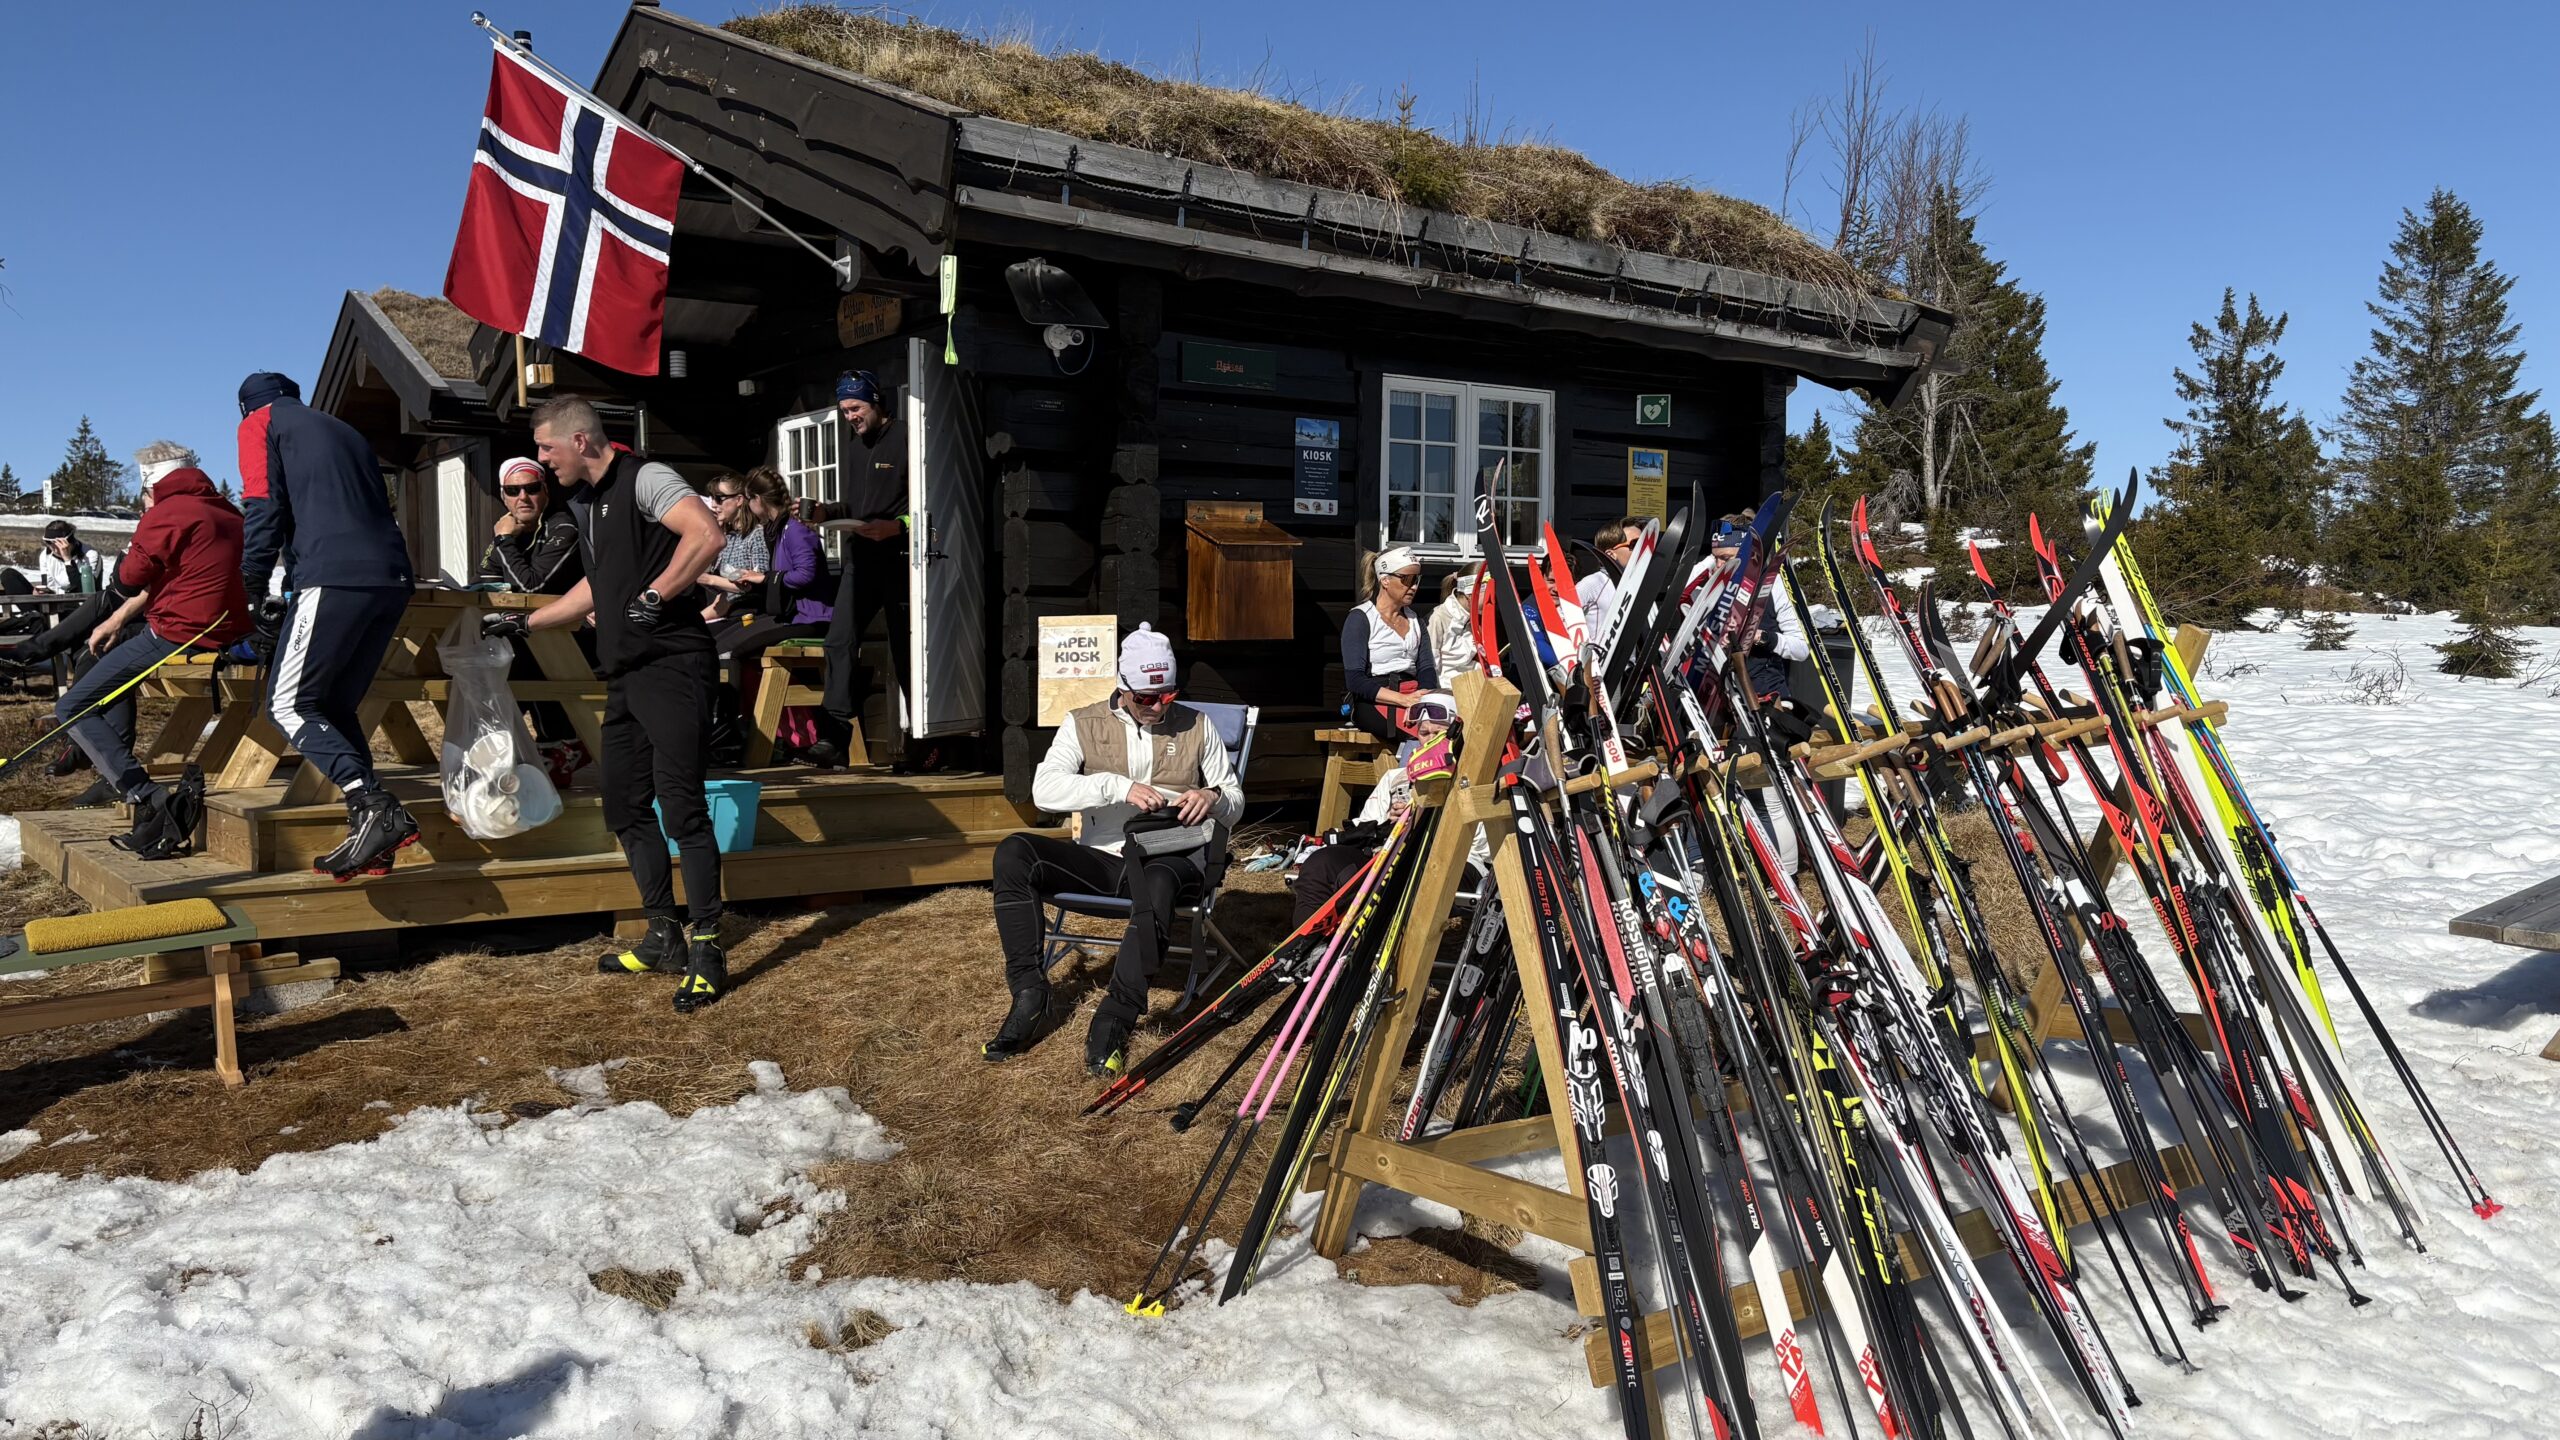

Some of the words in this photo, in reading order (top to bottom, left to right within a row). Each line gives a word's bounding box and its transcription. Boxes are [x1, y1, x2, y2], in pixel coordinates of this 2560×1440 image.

[1303, 450, 1332, 461] KIOSK
[2119, 541, 2173, 646] FISCHER
[294, 623, 304, 651] CRAFT
[1055, 651, 1100, 663] KIOSK
[1408, 759, 1433, 774] LEKI
[1600, 765, 1621, 840] SWIX
[2228, 837, 2264, 913] FISCHER
[1534, 868, 1551, 917] REDSTER
[1546, 920, 1556, 934] C9
[2171, 884, 2200, 949] ROSSIGNOL
[2151, 895, 2185, 955] ROSSIGNOL
[1611, 901, 1643, 996] ROSSIGNOL
[1617, 899, 1657, 994] ROSSIGNOL
[1240, 955, 1275, 989] ROSSIGNOL
[1353, 964, 1383, 1033] FISCHER
[2076, 987, 2091, 1014] R-SKIN
[1605, 1035, 1629, 1092] ATOMIC
[1901, 983, 1992, 1155] MADSHUS
[1740, 1179, 1751, 1202] COMP
[1747, 1203, 1760, 1230] DELTA
[1806, 1196, 1819, 1220] COMP
[1815, 1220, 1831, 1247] DELTA
[2238, 1247, 2257, 1272] 176
[1612, 1283, 1625, 1306] 192
[1776, 1328, 1796, 1357] DEL
[1621, 1338, 1637, 1388] SKINTEC
[1780, 1345, 1803, 1380] TA
